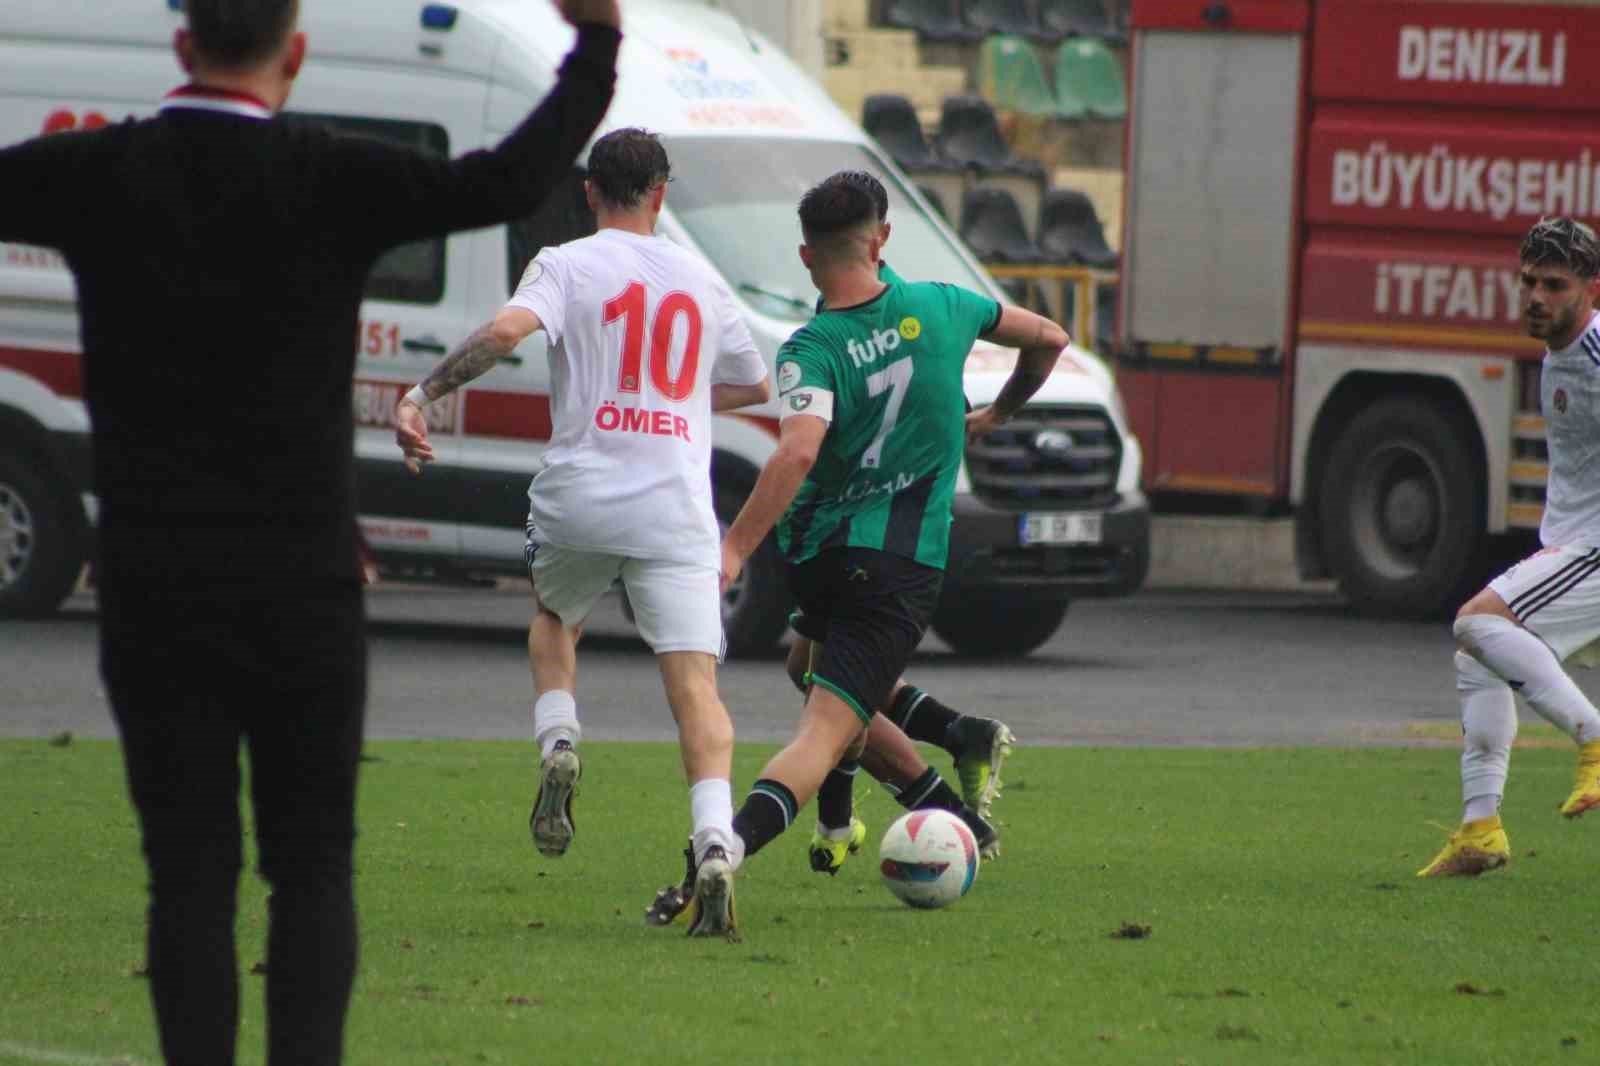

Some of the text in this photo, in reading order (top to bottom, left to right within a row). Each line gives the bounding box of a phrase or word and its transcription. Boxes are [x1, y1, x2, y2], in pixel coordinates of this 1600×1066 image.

[602, 280, 703, 402] 10
[595, 400, 692, 443] ÖMER
[866, 355, 915, 469] 7
